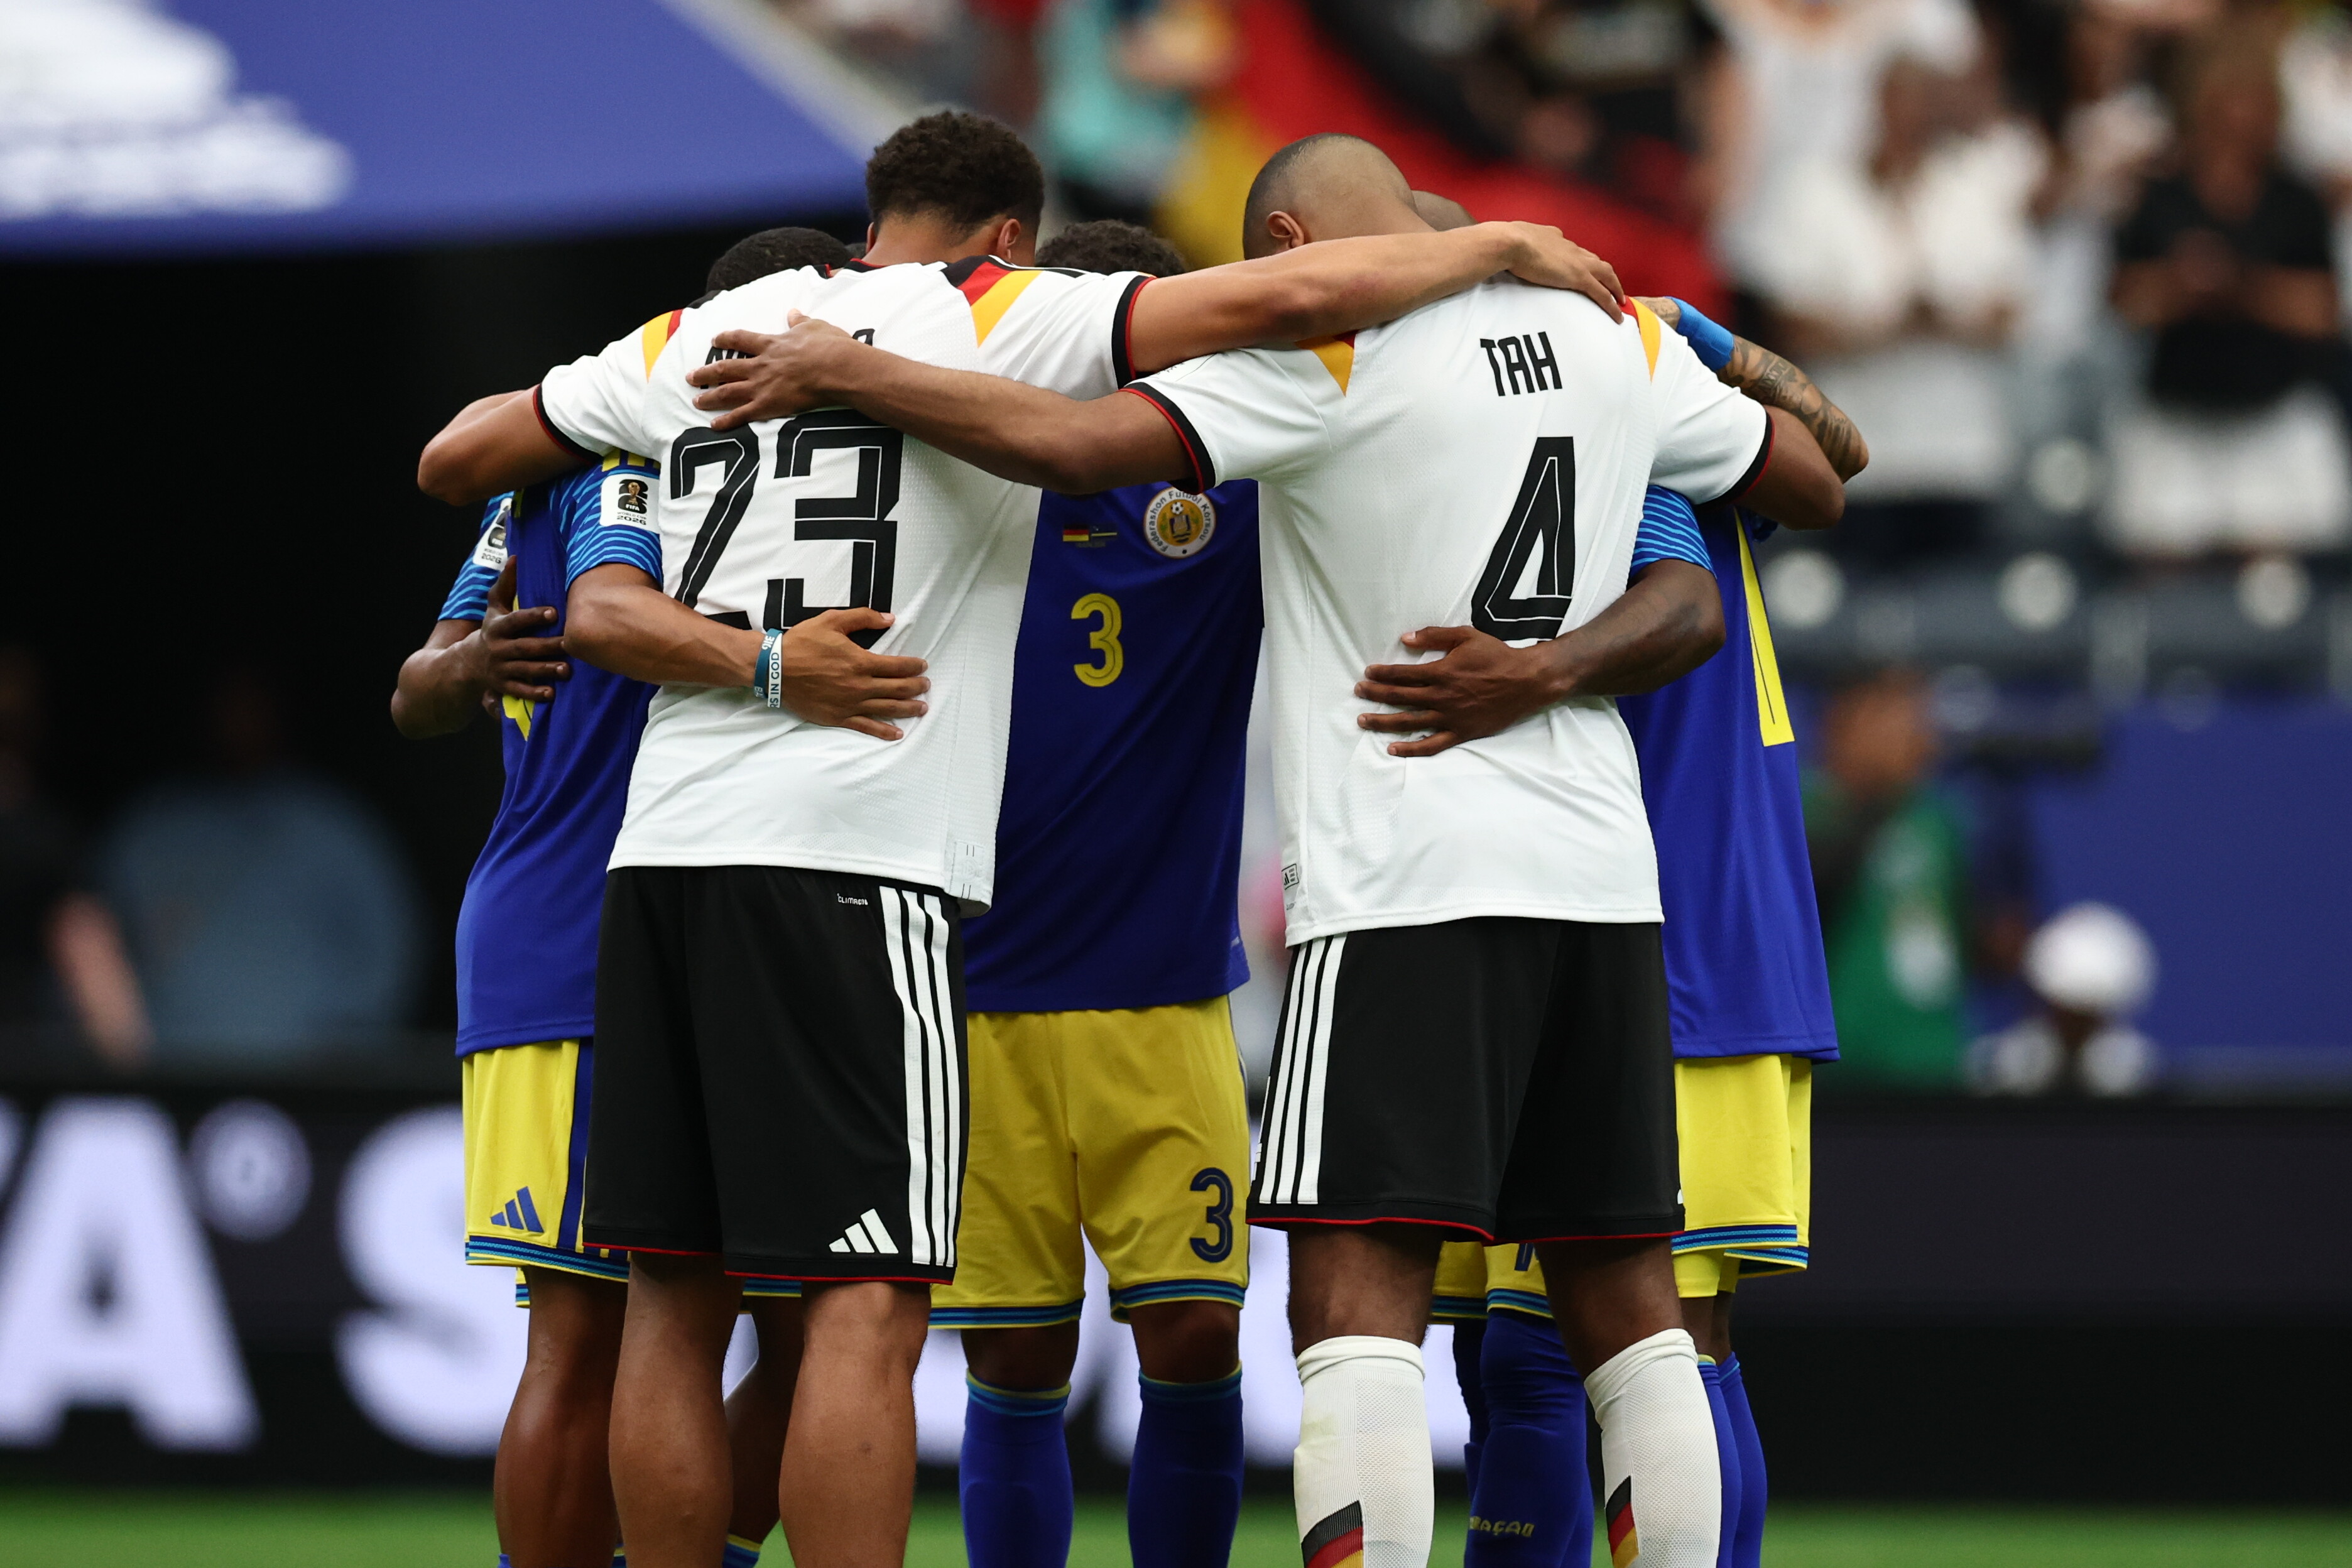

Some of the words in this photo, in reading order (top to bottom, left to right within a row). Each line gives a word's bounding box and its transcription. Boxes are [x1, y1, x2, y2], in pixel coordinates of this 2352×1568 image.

[1480, 331, 1562, 396] TAH
[616, 515, 647, 525] 2026
[670, 408, 904, 650] 23
[1471, 436, 1576, 643] 4
[481, 553, 502, 564] 2026
[770, 652, 780, 680] GOD
[1070, 592, 1124, 687] 3
[770, 683, 780, 695] IN
[1189, 1167, 1234, 1263] 3
